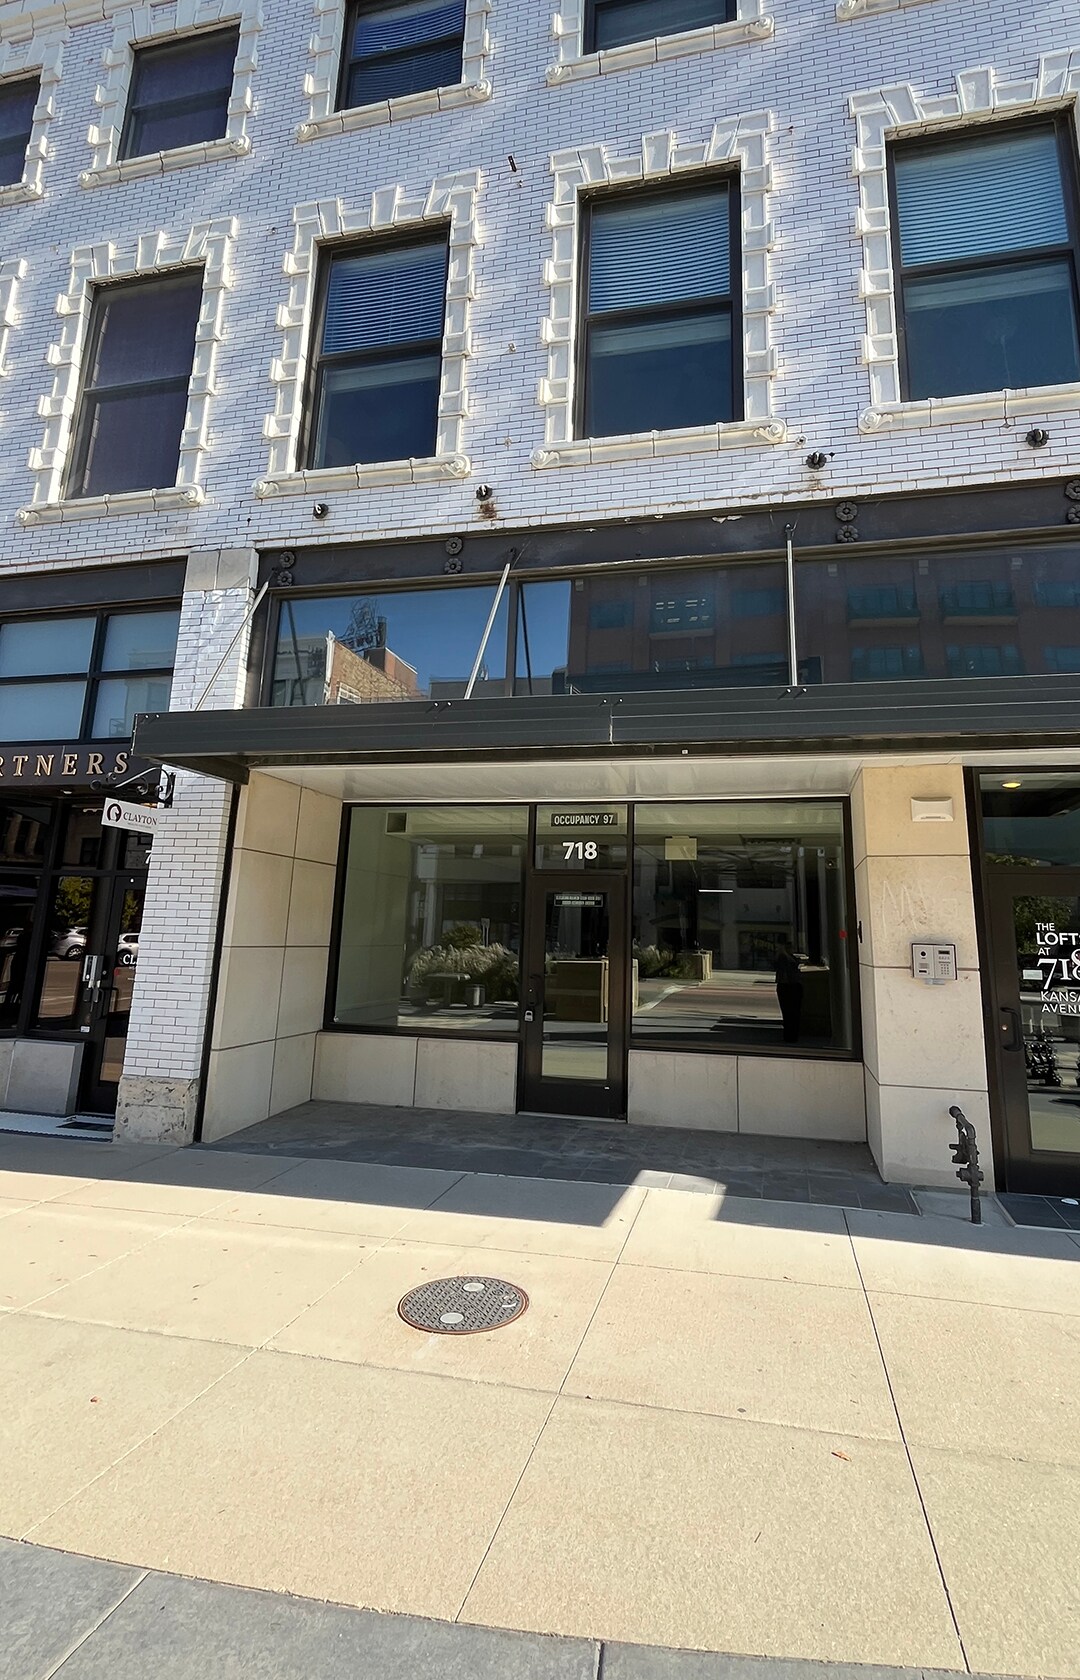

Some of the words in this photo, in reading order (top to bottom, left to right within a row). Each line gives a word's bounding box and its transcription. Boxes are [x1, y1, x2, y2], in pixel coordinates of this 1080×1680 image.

[0, 752, 128, 777] TNERS
[123, 811, 158, 825] CLAYTON
[554, 815, 600, 825] OCCUPANCY
[603, 814, 614, 824] 97
[562, 841, 598, 860] 718
[1035, 922, 1056, 931] THE
[1036, 932, 1080, 946] LOFT
[1038, 947, 1051, 955] AT
[1041, 991, 1080, 1002] KANS
[1041, 1003, 1080, 1014] AVEN
